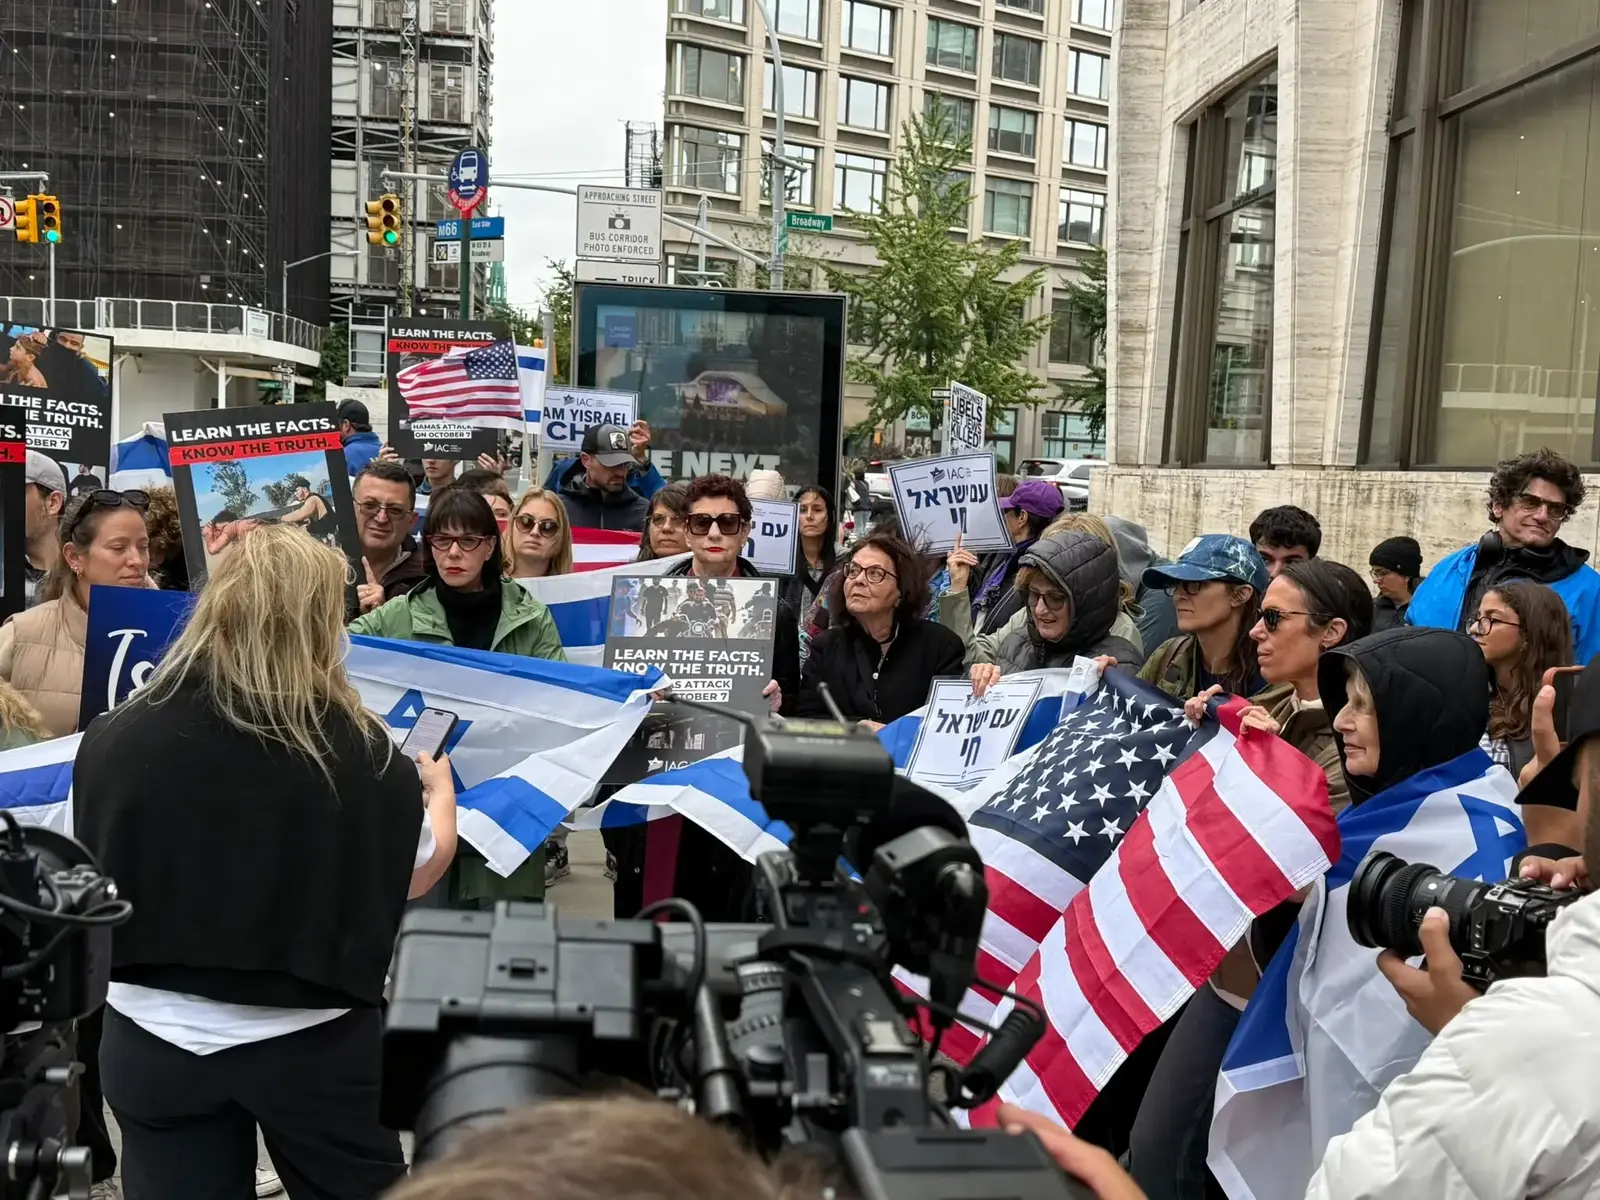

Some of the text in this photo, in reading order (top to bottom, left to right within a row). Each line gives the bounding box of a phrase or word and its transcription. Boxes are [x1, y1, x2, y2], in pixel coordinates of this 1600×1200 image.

[584, 190, 657, 204] APPROACHING STREET
[438, 222, 458, 236] M66
[792, 214, 826, 230] Broadway
[589, 232, 649, 244] BUS CORRIDOR
[584, 243, 654, 255] PHOTO ENFORCED
[392, 328, 496, 340] LEARN THE FACTS.
[396, 341, 430, 350] KNOW
[8, 394, 42, 409] THE
[46, 399, 103, 416] FACTS.
[576, 398, 593, 407] IAC
[952, 394, 982, 422] LIBELS
[44, 411, 104, 429] TRUTH.
[543, 406, 629, 426] AM YISRAEL
[952, 410, 982, 434] GET JEWS
[26, 426, 70, 438] ATTACK
[172, 418, 336, 442] LEARN THE FACTS.
[546, 421, 590, 442] CH
[26, 438, 68, 448] OBER 7
[182, 438, 332, 460] KNOW THE TRUTH.
[434, 444, 450, 452] IAC
[682, 451, 780, 482] NEXT
[946, 467, 965, 480] IAC
[762, 522, 788, 538] עם
[614, 649, 765, 663] LEARN THE FACTS.
[672, 662, 702, 674] THE
[705, 663, 765, 676] TRUTH.
[684, 680, 730, 689] ATTACK
[678, 692, 728, 700] TOBER 7
[936, 708, 1020, 734] עם ישראל
[960, 736, 982, 768] חי
[664, 759, 688, 772] IAC
